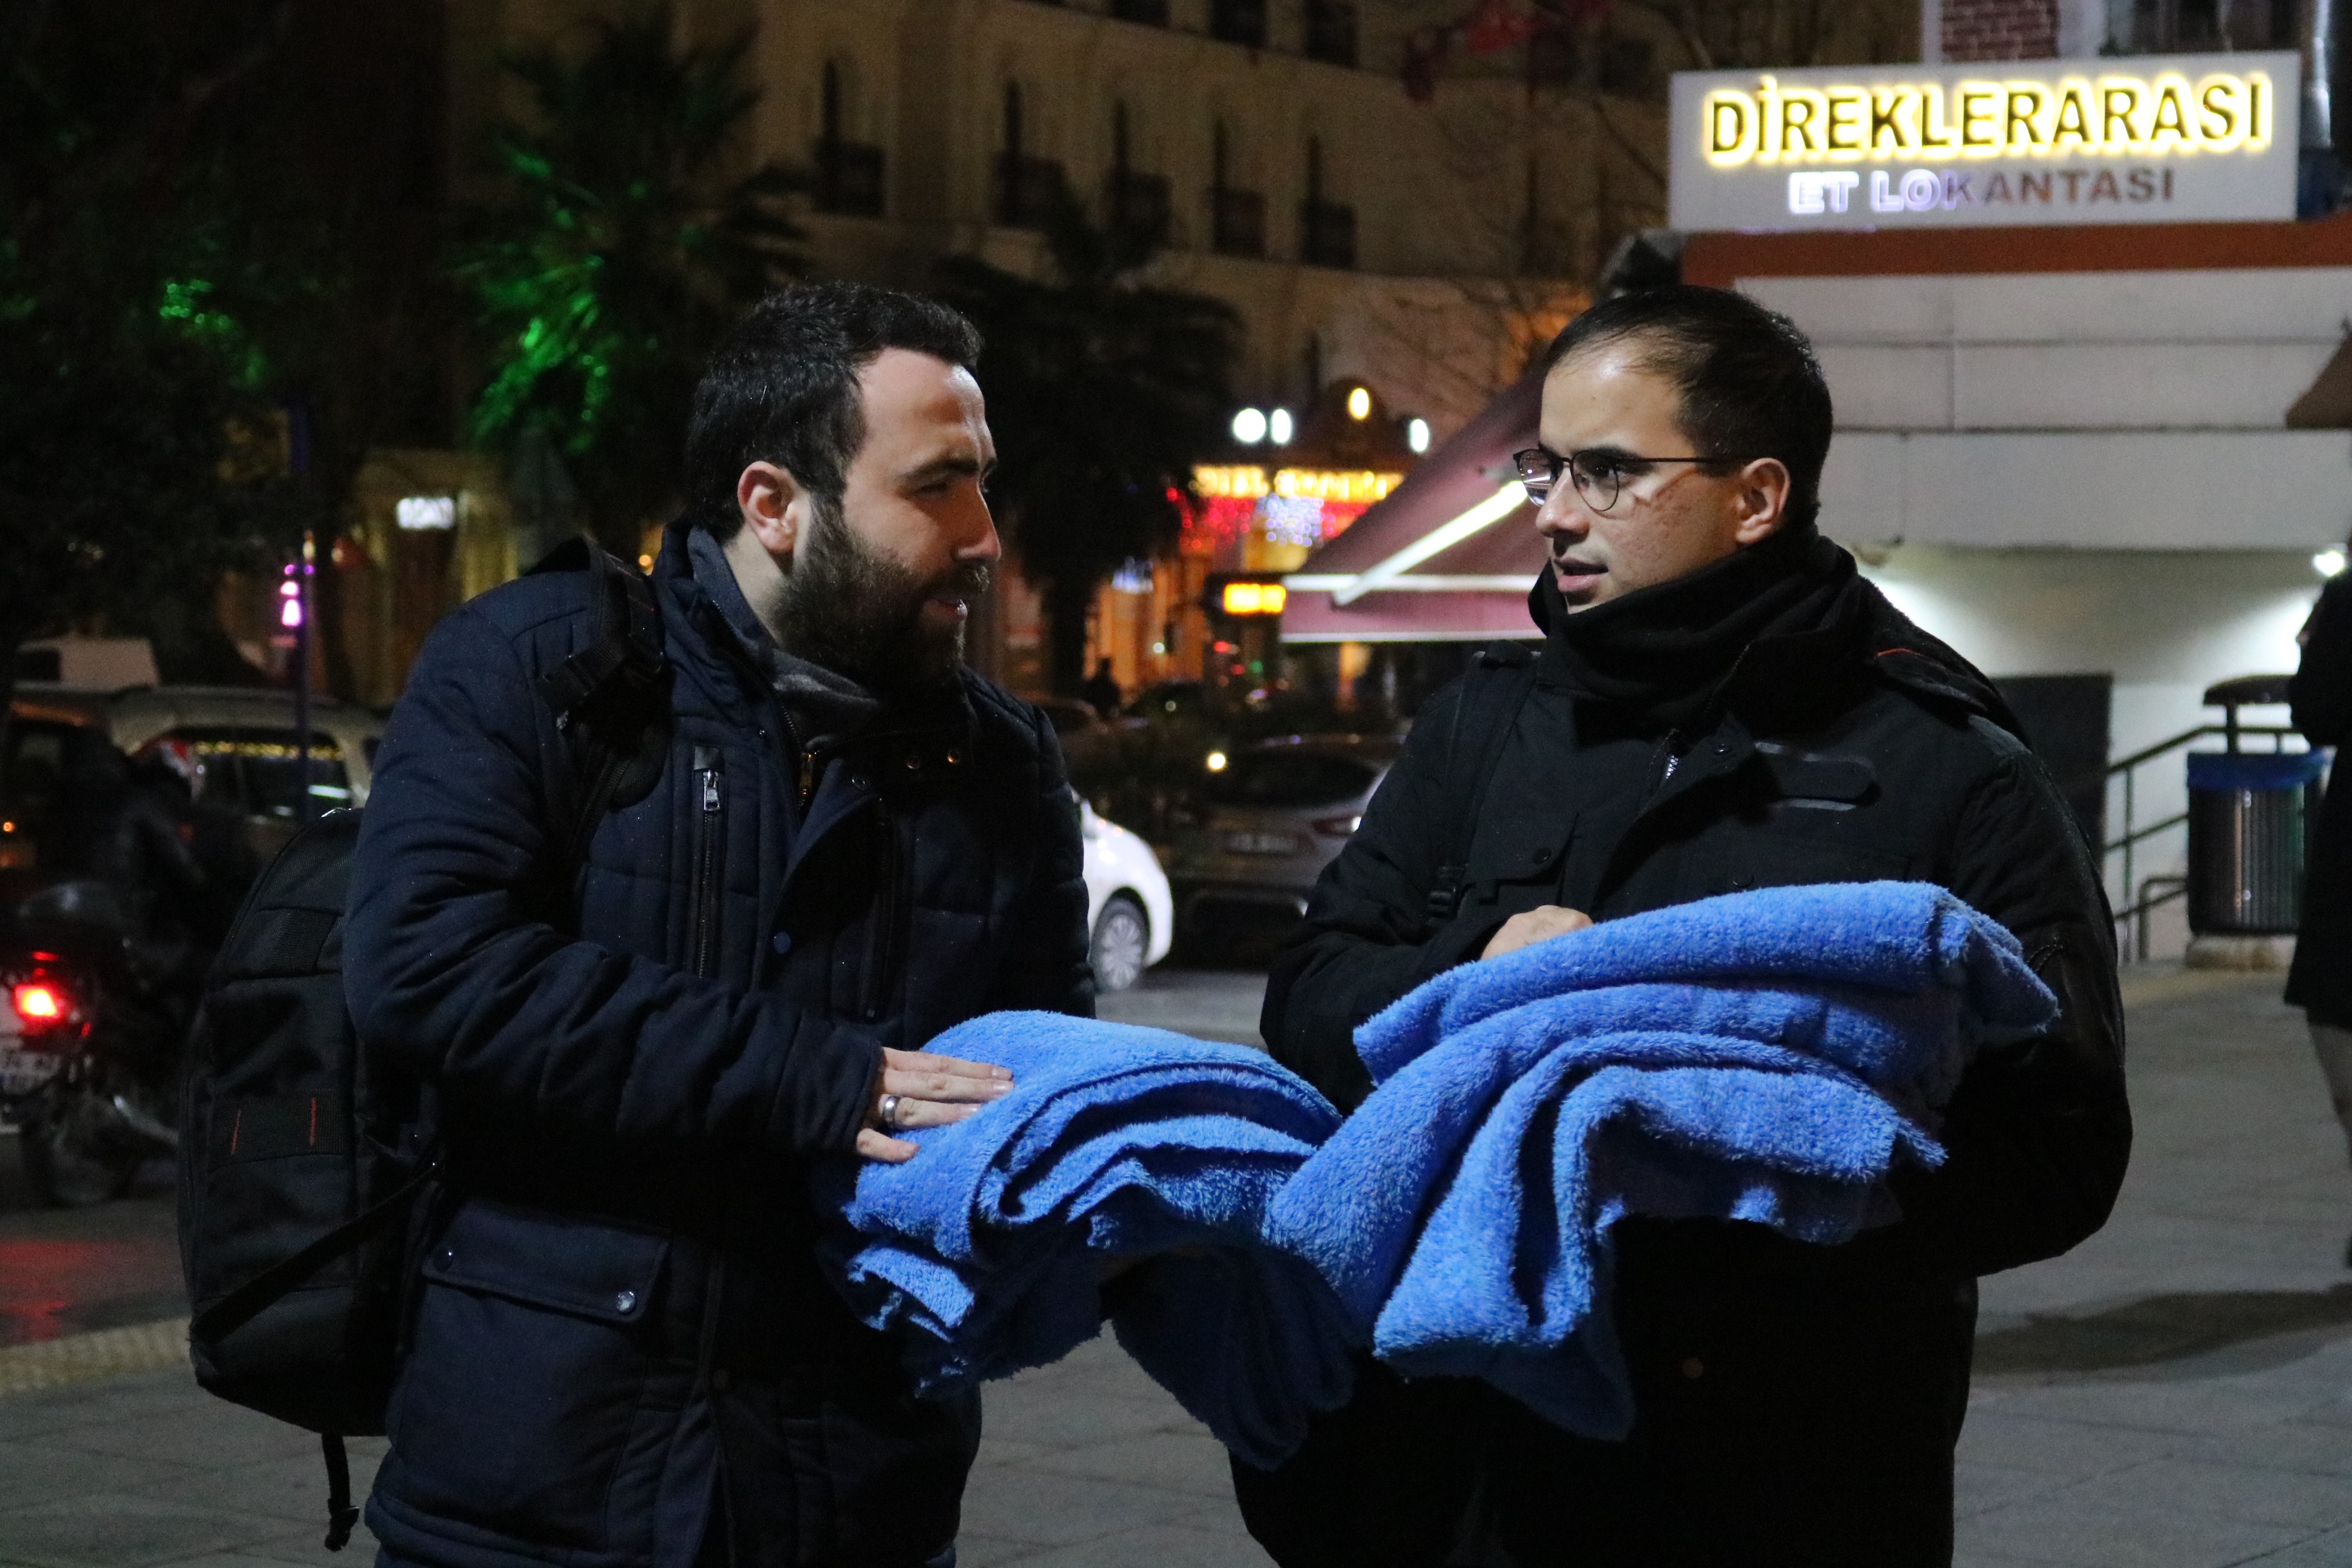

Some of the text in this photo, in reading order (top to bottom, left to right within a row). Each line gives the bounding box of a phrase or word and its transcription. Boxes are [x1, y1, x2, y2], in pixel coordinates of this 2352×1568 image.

[1707, 72, 2272, 162] DİREKLERARASI
[1790, 166, 2175, 213] ET LOKANTASI
